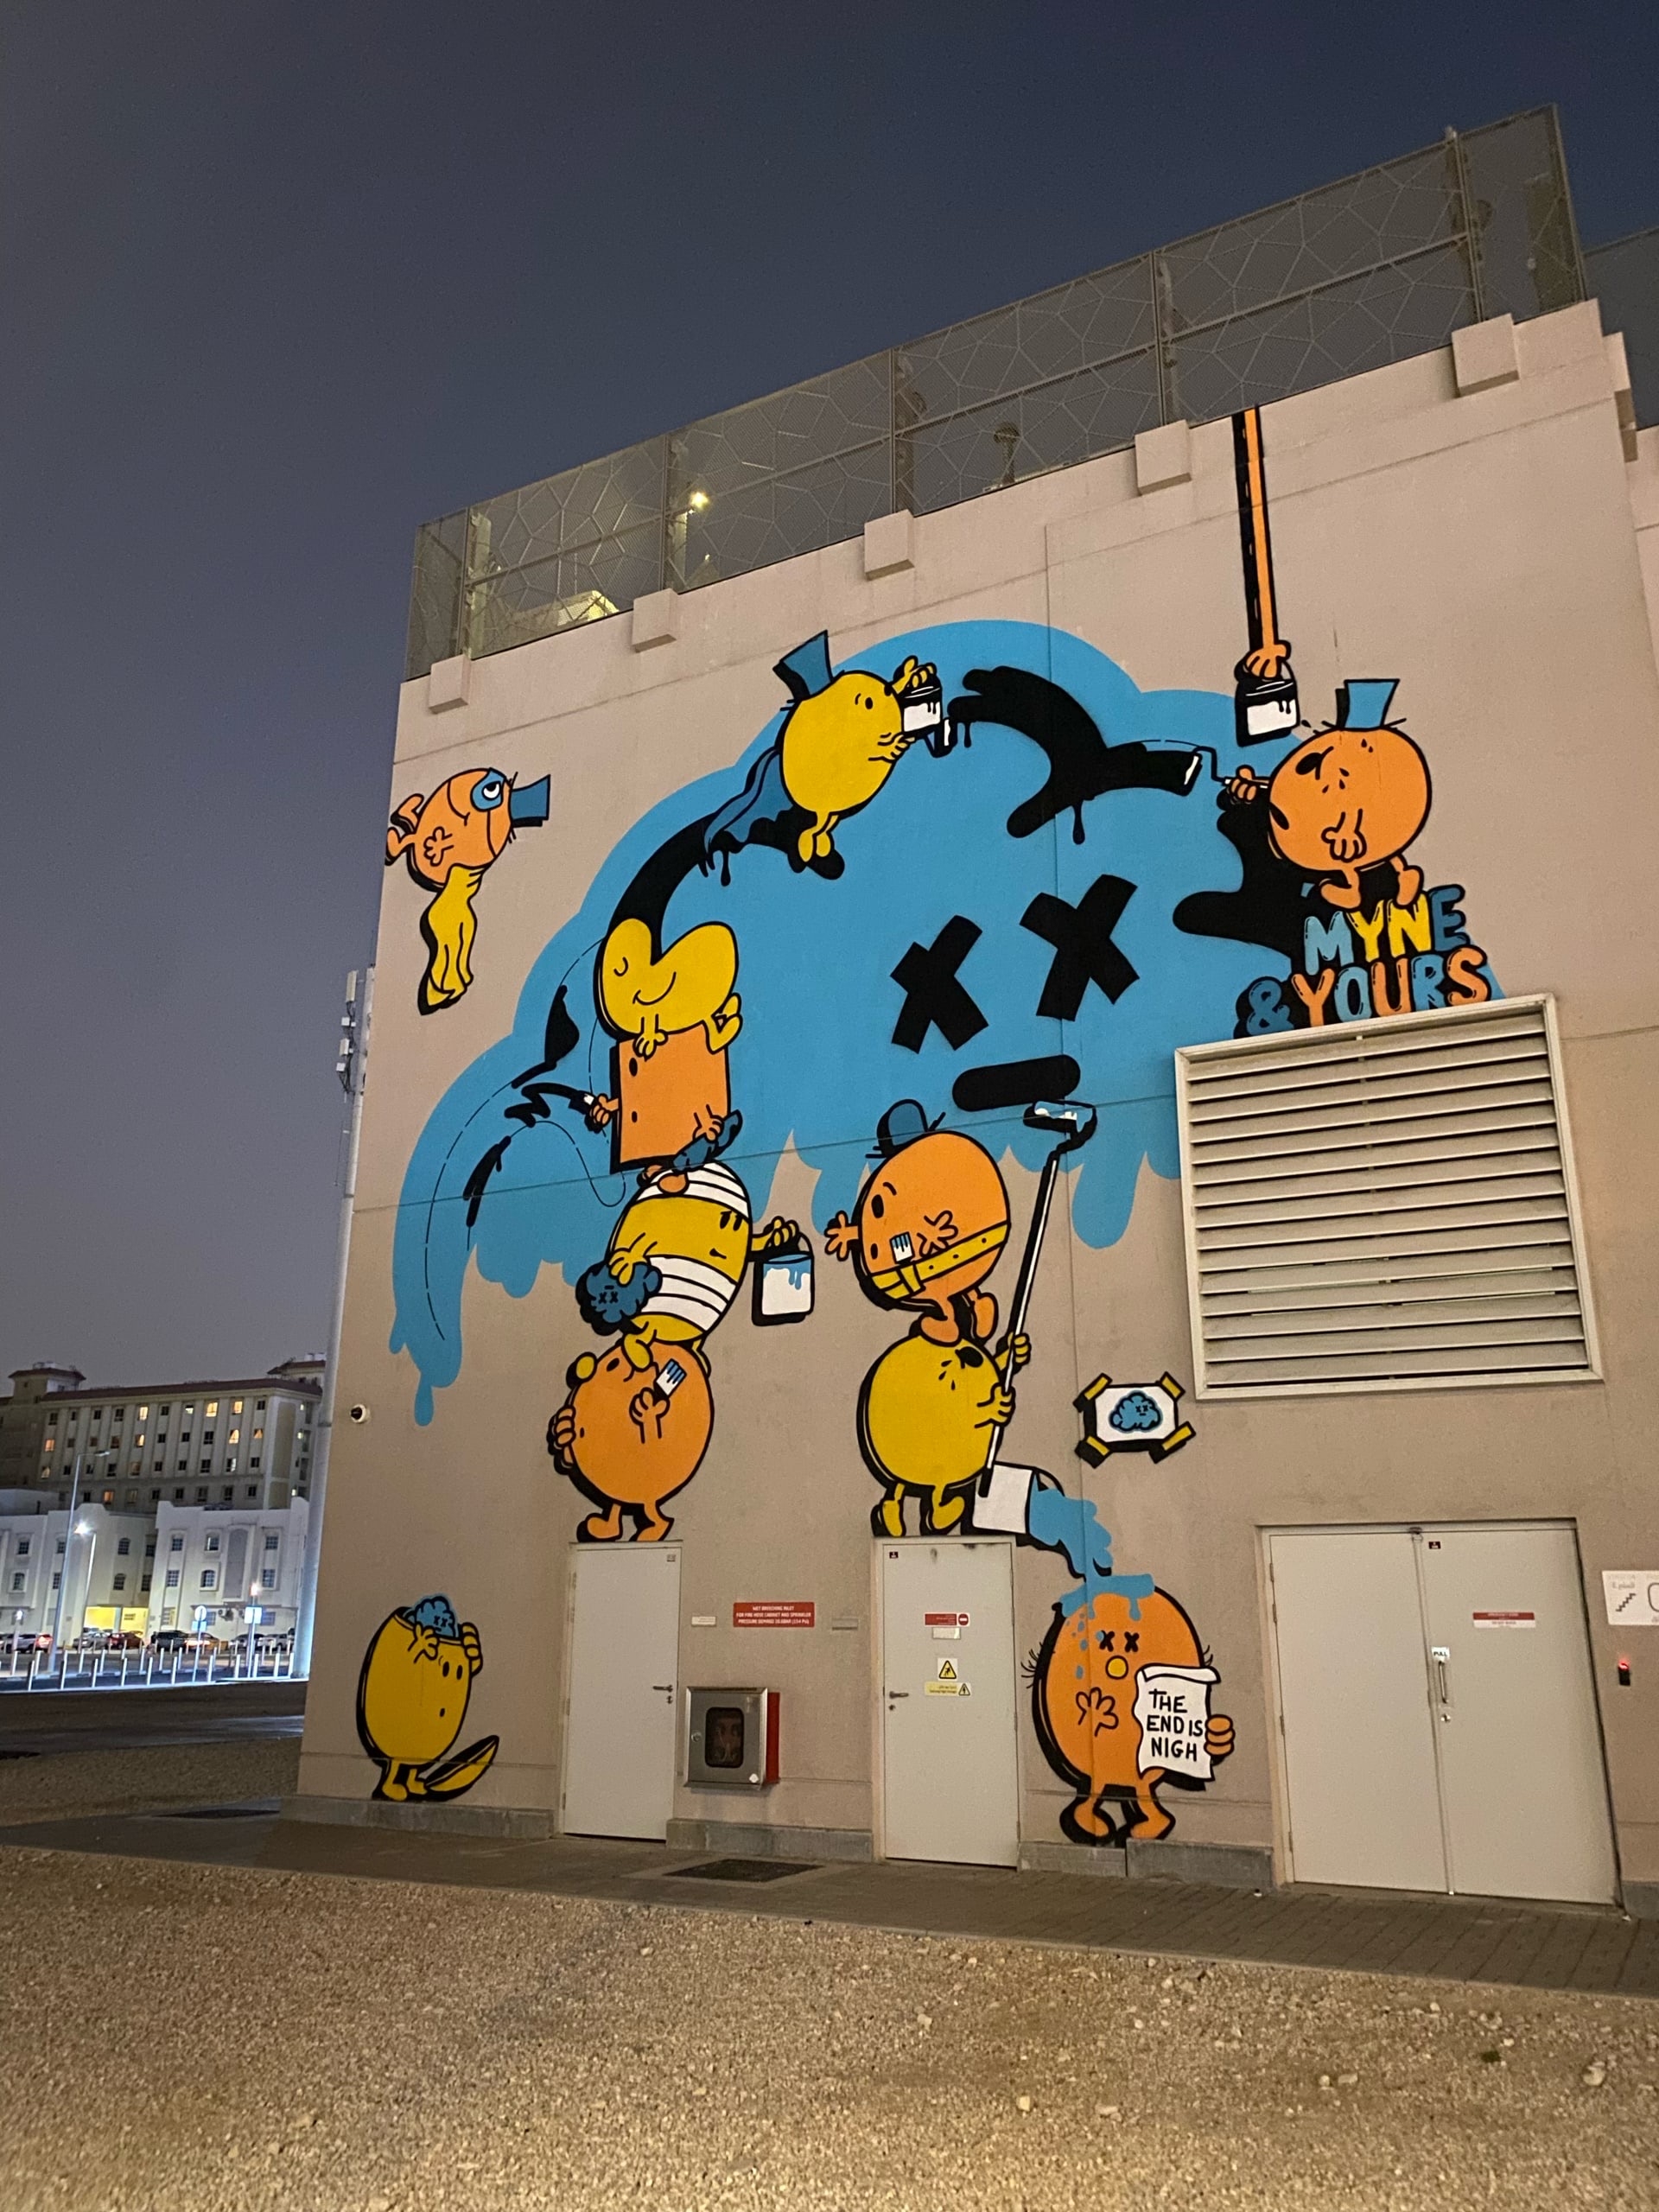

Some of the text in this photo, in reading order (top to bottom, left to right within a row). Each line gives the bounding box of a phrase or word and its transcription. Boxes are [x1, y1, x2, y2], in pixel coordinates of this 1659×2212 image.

[1303, 886, 1468, 976] MYNE
[1245, 947, 1489, 1036] & YOURS
[1148, 1688, 1187, 1713] THE
[1147, 1715, 1203, 1737] END IS
[1151, 1738, 1198, 1762] NIGH
